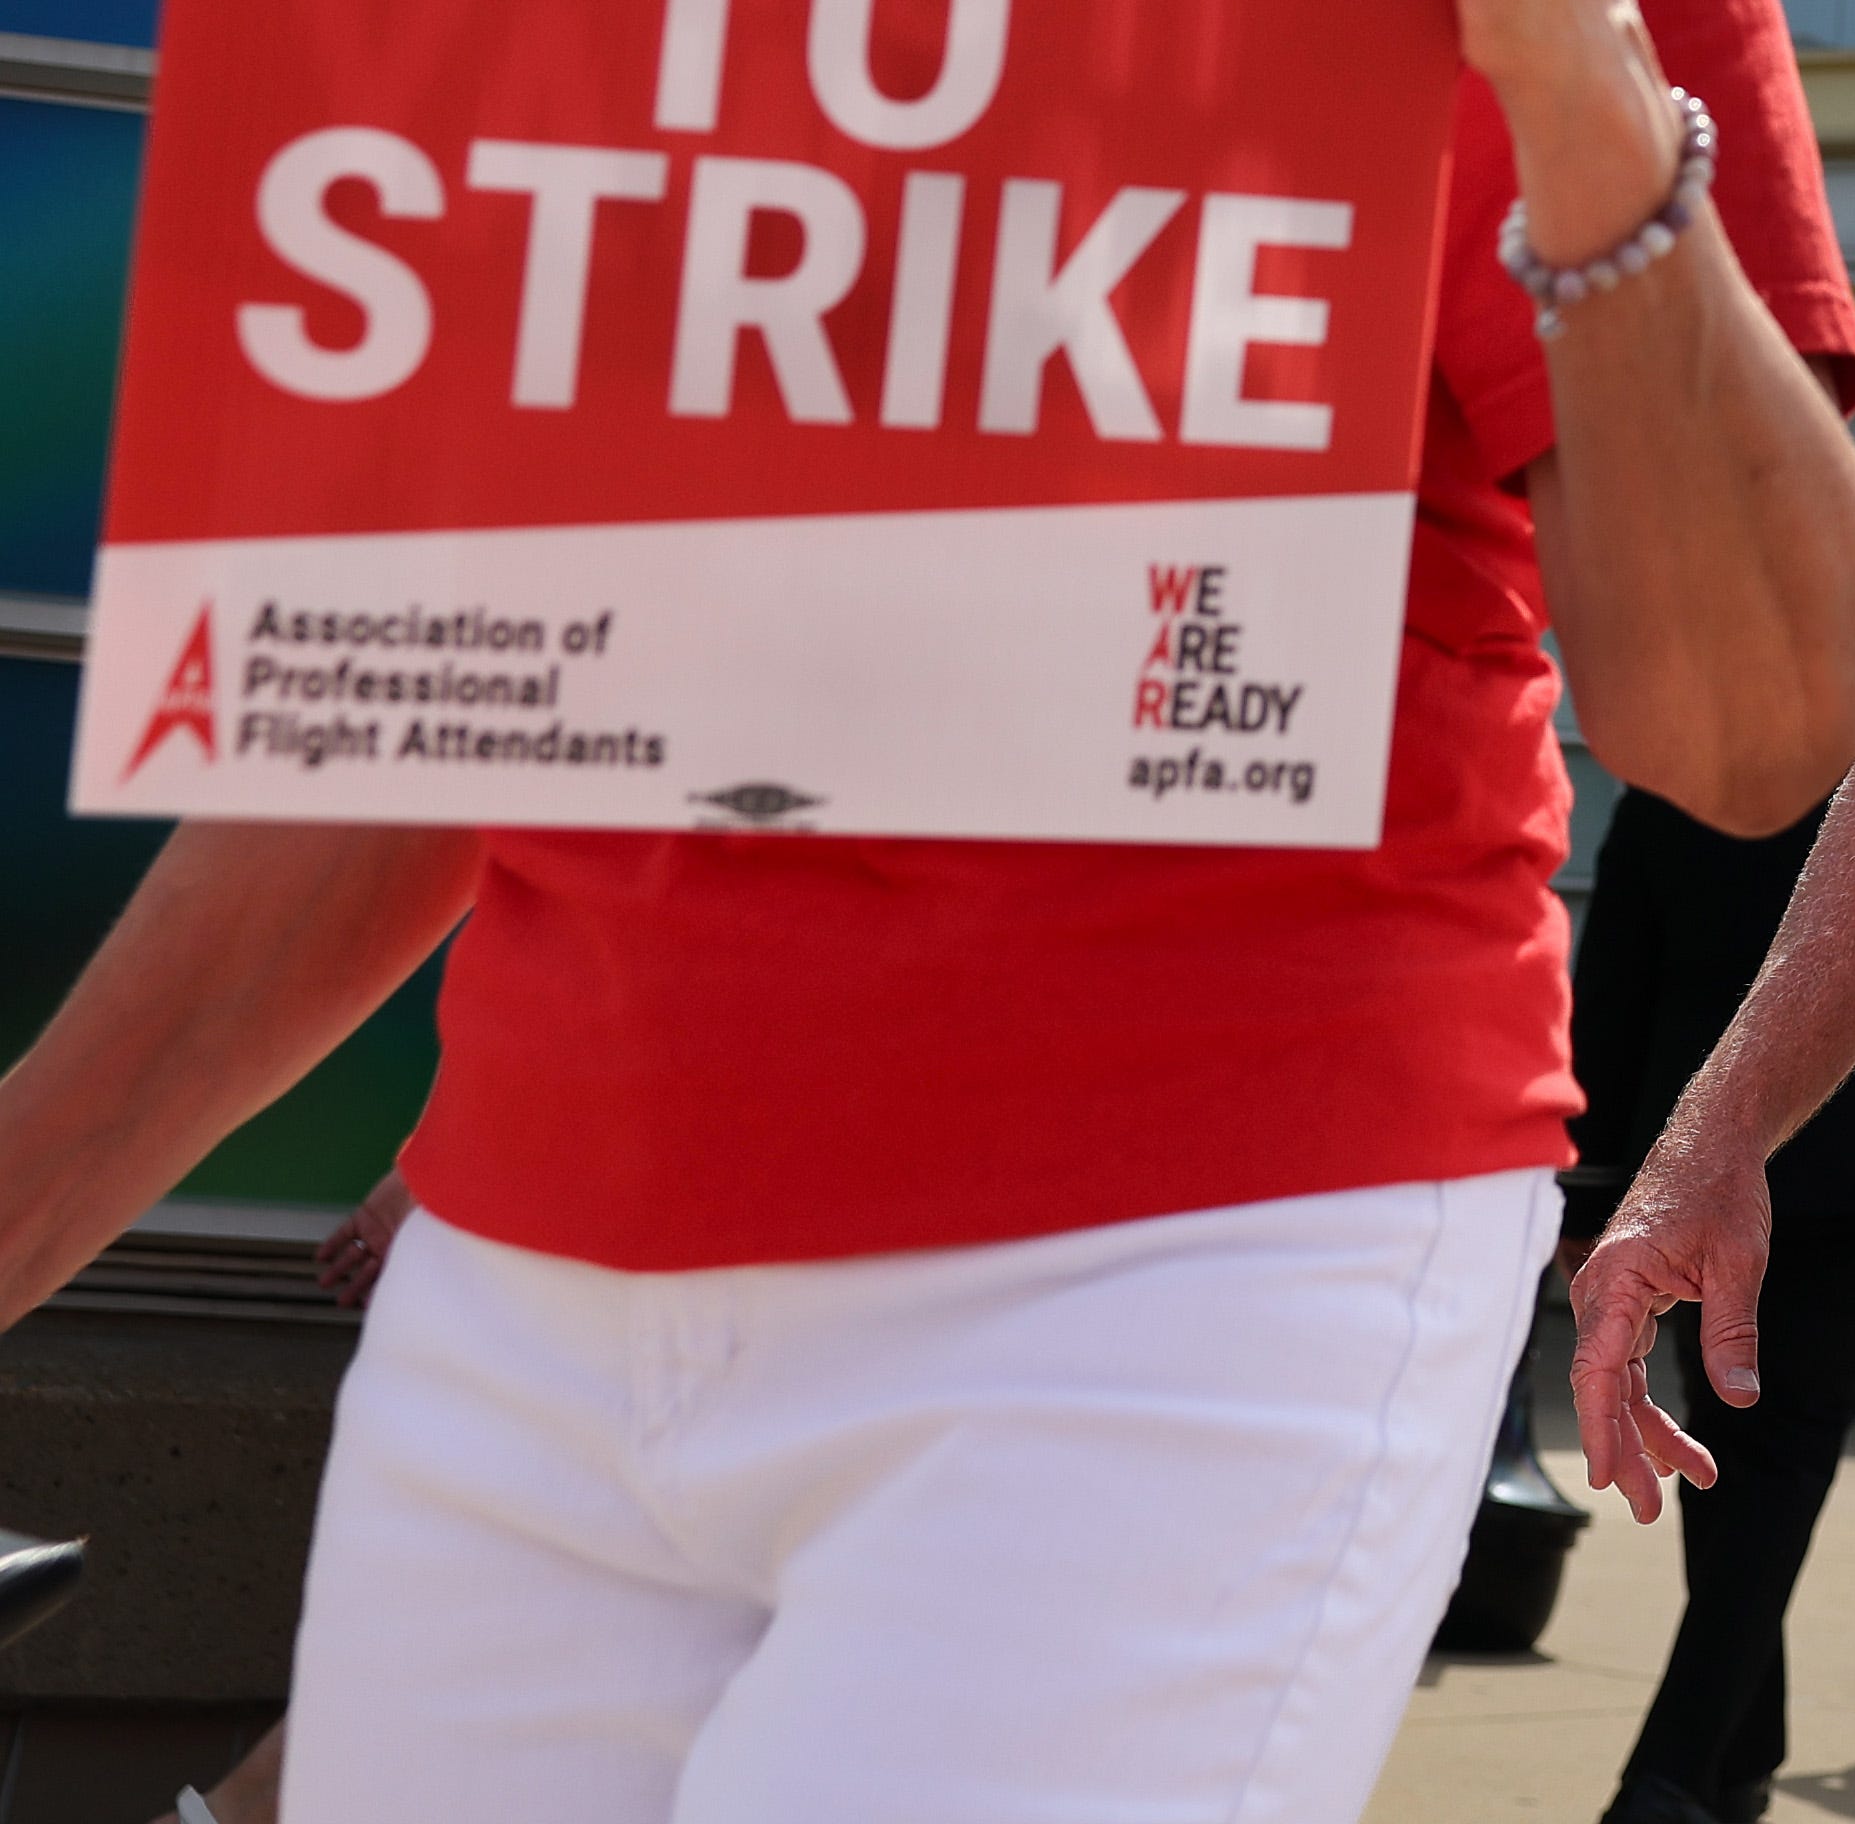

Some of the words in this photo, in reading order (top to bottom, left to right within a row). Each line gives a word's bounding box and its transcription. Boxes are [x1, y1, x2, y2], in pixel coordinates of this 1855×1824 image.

[235, 126, 1355, 454] STRIKE
[1147, 564, 1226, 616] WE
[249, 600, 549, 654] Association
[558, 610, 613, 656] of
[1140, 620, 1242, 675] ARE
[241, 656, 560, 712] Professional
[1132, 677, 1304, 734] READY
[235, 712, 380, 774] Flight
[396, 720, 667, 772] Attendants
[1128, 748, 1316, 804] apfa.org
